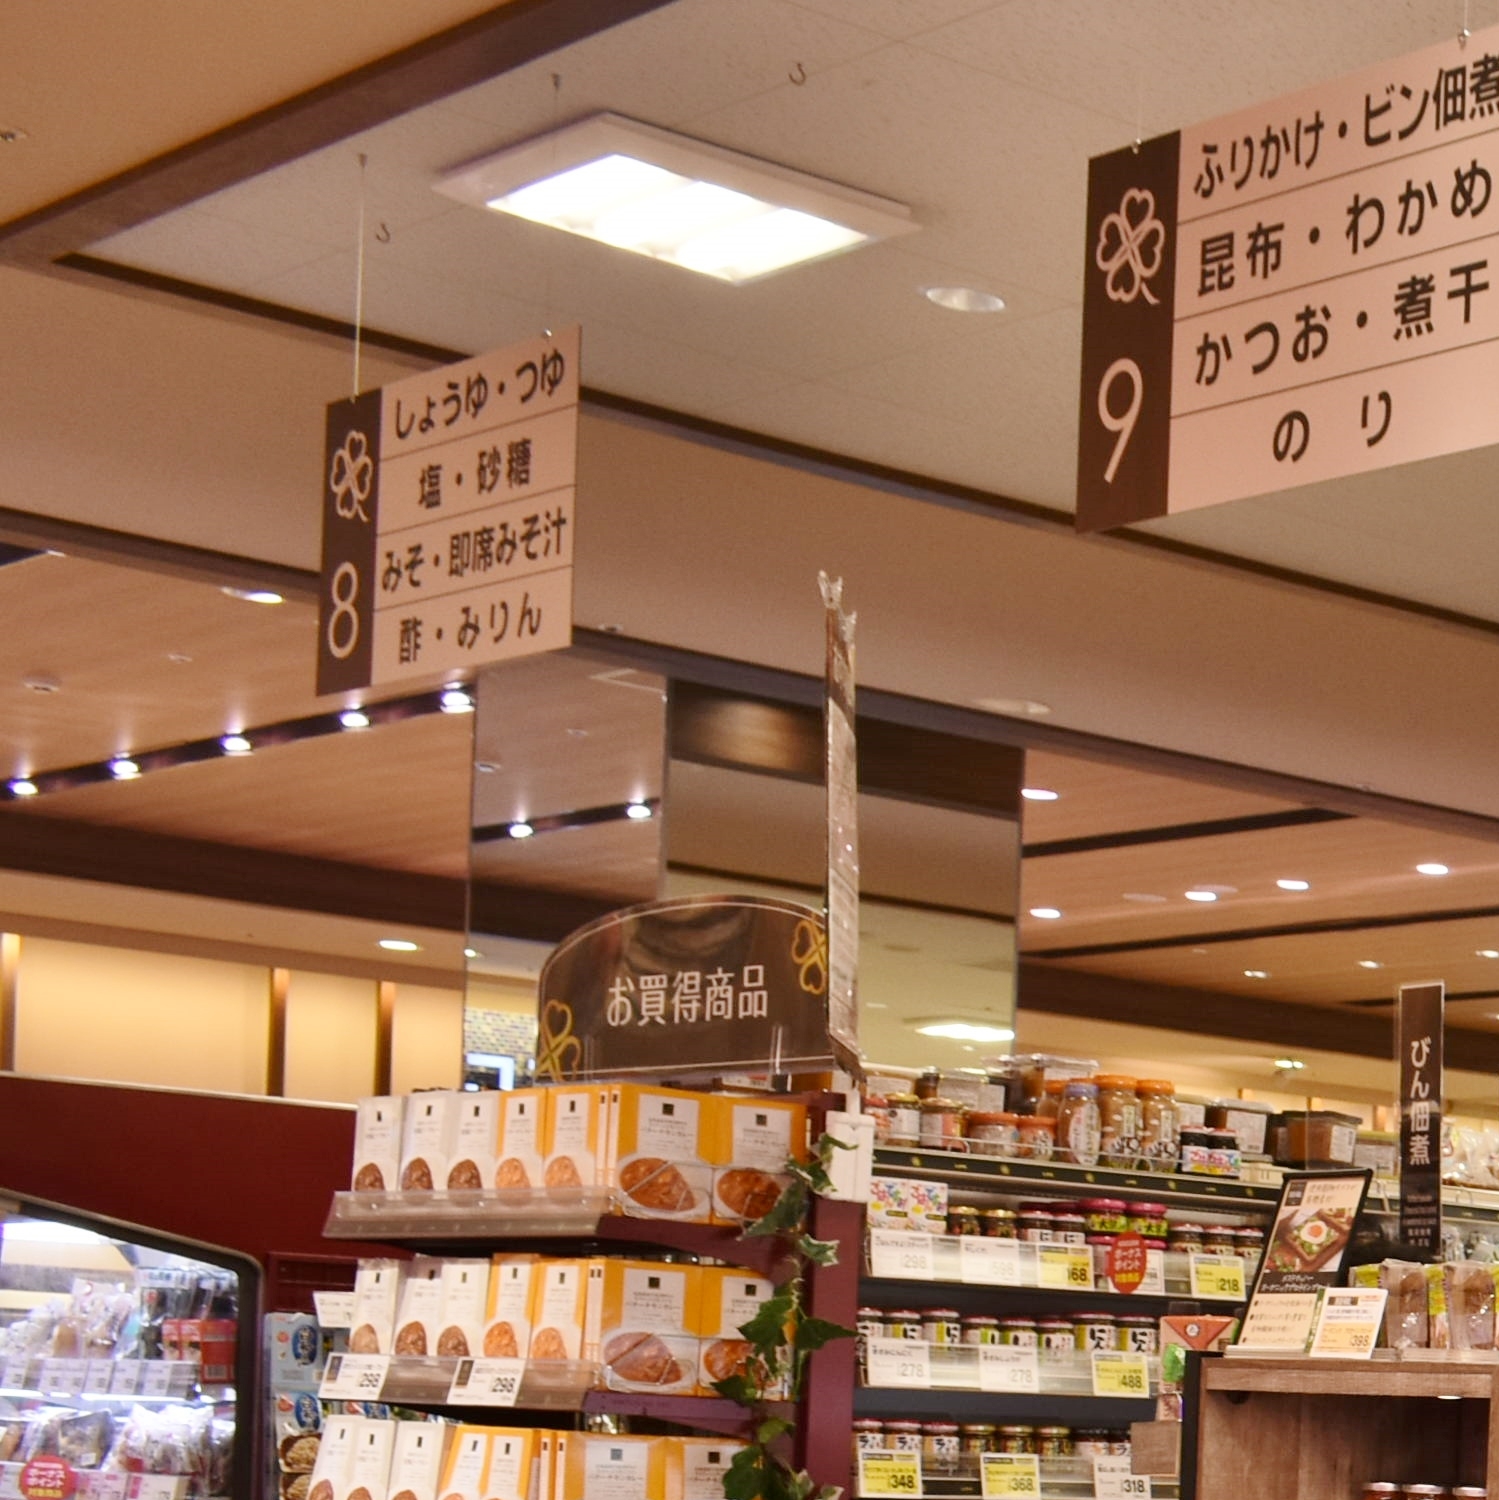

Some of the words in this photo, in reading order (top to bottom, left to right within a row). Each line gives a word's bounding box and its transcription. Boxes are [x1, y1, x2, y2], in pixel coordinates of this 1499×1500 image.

[1197, 159, 1493, 298] 昆布・わかめ
[1195, 259, 1491, 387] かつお・煮干
[395, 348, 566, 440] しょうゆ・つゆ
[1097, 357, 1144, 484] 9
[418, 438, 533, 509] 塩・砂糖
[381, 506, 568, 592] みそ・即席みそ汁
[328, 561, 359, 659] 8
[399, 592, 542, 664] 酢・みりん
[606, 963, 769, 1028] お買得商品
[1409, 1037, 1432, 1167] びん佃煮
[1120, 1372, 1144, 1390] 488
[892, 1472, 917, 1490] 348
[1122, 1477, 1147, 1495] 318
